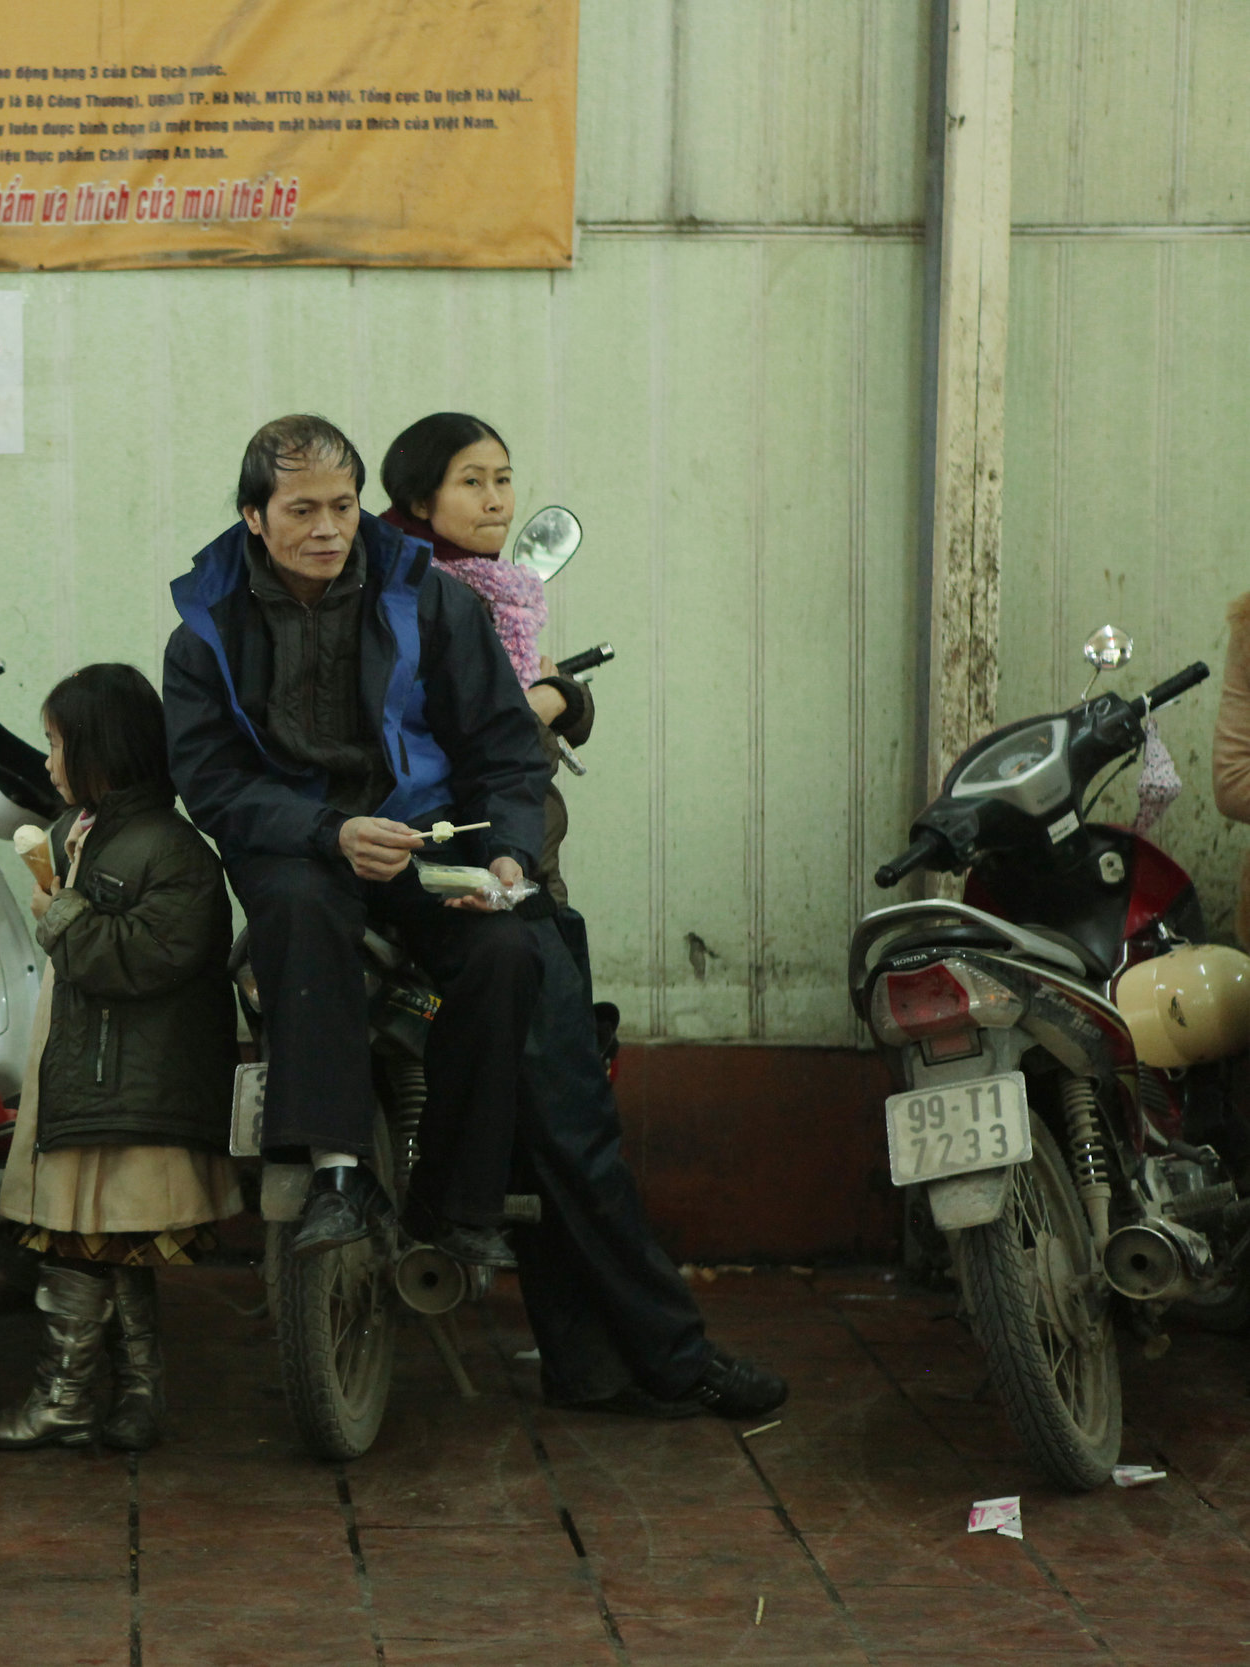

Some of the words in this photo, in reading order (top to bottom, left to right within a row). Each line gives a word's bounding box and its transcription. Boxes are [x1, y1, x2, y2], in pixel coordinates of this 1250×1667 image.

[90, 66, 98, 79] 3
[265, 91, 302, 105] MTTQ
[424, 90, 442, 103] Du
[194, 119, 229, 133] trong
[173, 146, 191, 159] An
[74, 180, 129, 223] thích
[136, 175, 175, 221] của
[182, 180, 225, 229] mọi
[231, 172, 273, 220] thế
[270, 177, 299, 228] hệ
[892, 953, 928, 967] HONDA
[907, 1083, 1002, 1134] 99-T1
[910, 1123, 1008, 1175] 7233
